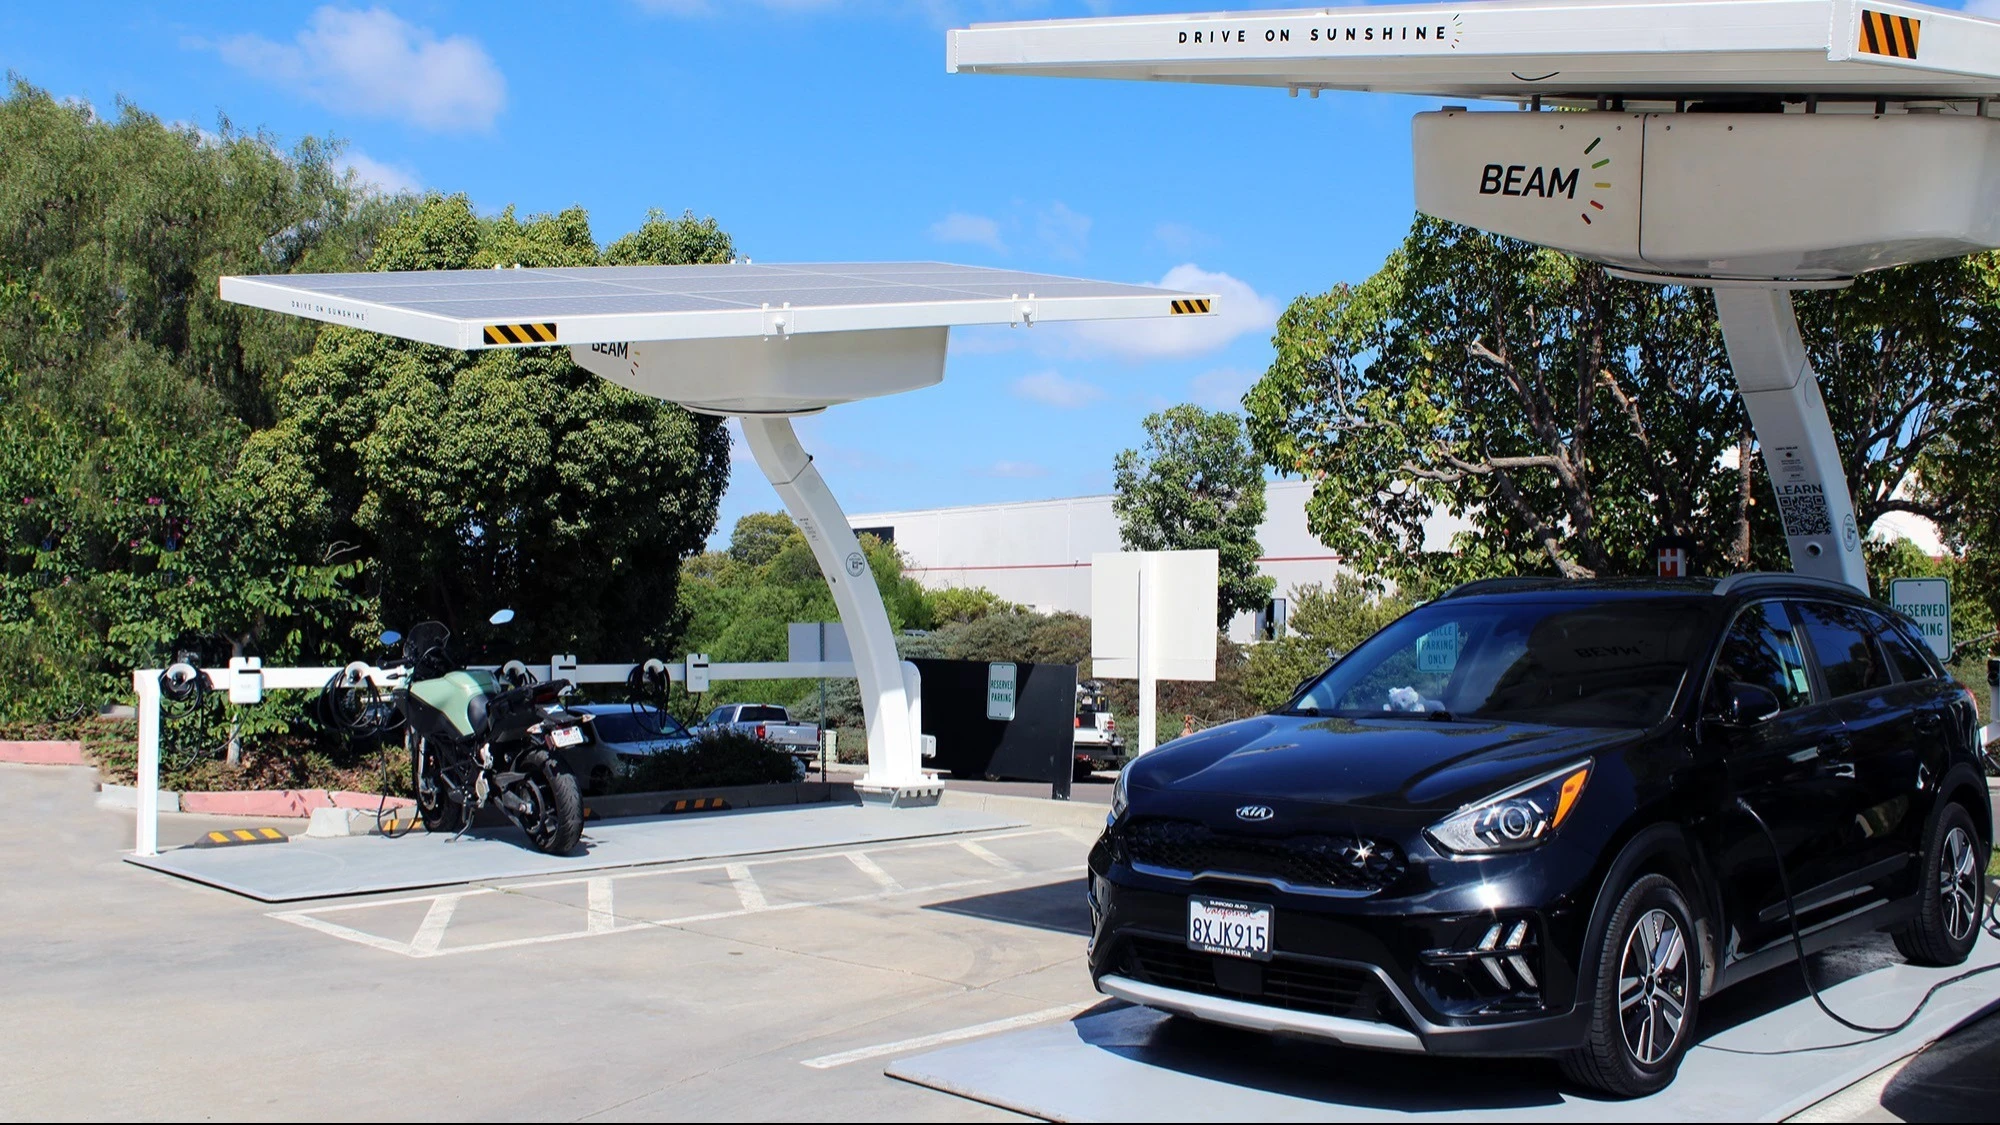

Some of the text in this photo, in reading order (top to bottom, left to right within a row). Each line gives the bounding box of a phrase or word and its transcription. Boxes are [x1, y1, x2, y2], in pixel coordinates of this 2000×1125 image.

[1178, 26, 1446, 44] DRIVE ON SUNSHINE
[1479, 163, 1581, 200] BEAM
[291, 301, 311, 310] DRIVE
[328, 307, 364, 320] SUNSHINE
[591, 342, 628, 359] BEAM
[1775, 484, 1823, 496] LEARN
[1896, 603, 1946, 617] RESERVED
[1918, 622, 1943, 636] KING
[1421, 640, 1454, 650] PARKING
[1428, 654, 1447, 664] ONLY
[990, 680, 1013, 690] RESERVED
[991, 692, 1011, 702] PARKING
[1240, 806, 1265, 817] KIA
[1193, 917, 1266, 952] 8XJK915
[1225, 947, 1241, 955] Mesa
[1241, 950, 1252, 958] Kia
